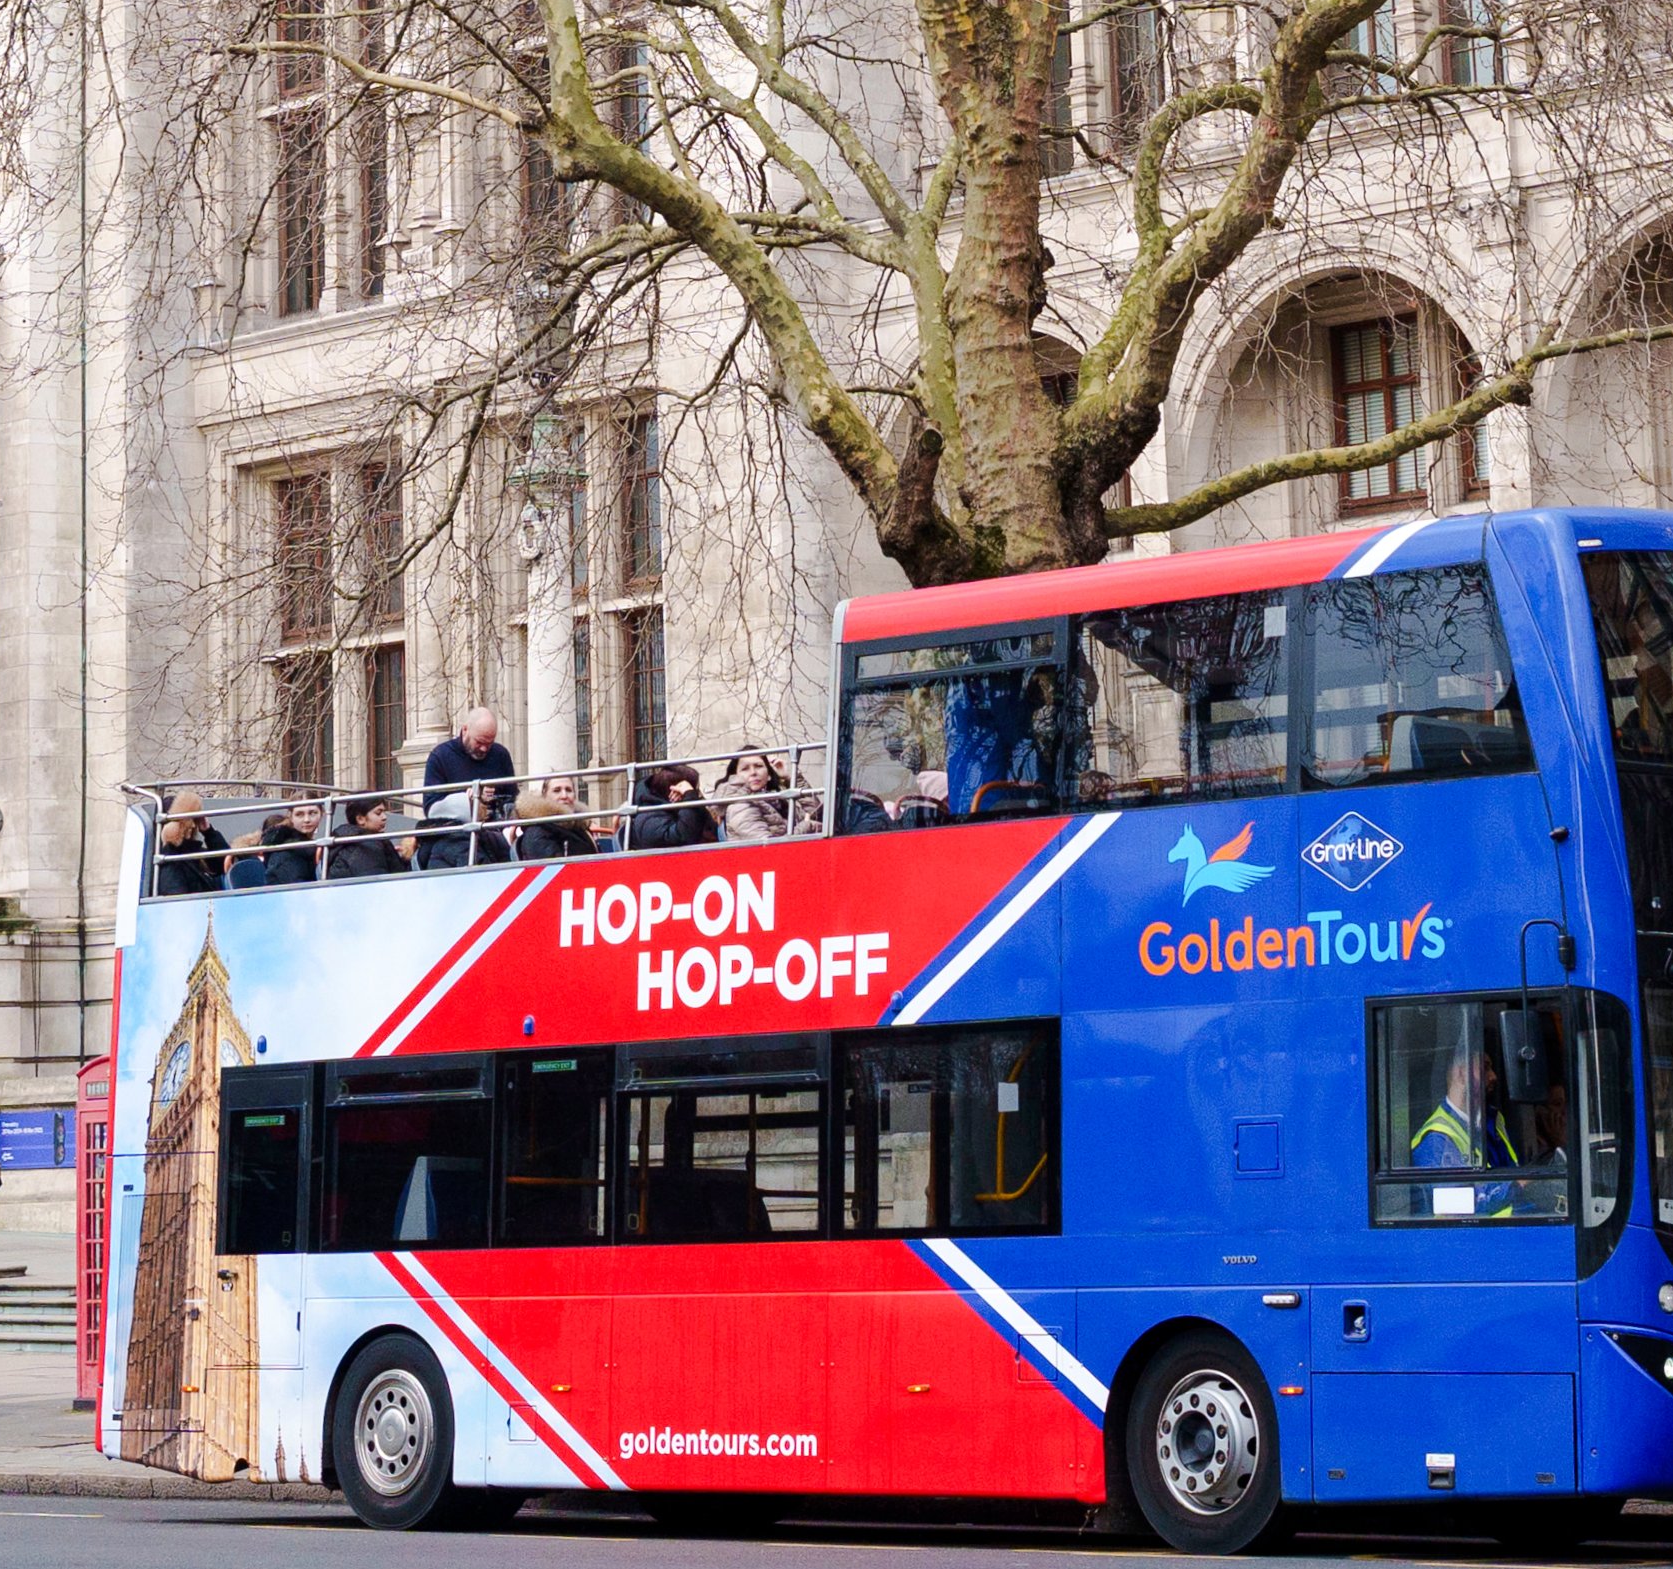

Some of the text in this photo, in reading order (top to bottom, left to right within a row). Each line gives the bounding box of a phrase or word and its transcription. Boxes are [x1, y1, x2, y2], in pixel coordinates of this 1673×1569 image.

[559, 871, 776, 948] HOP-ON
[637, 932, 890, 1012] HOP-OFF
[1222, 1255, 1257, 1265] VOLVO
[619, 1426, 818, 1459] goldentours.com
